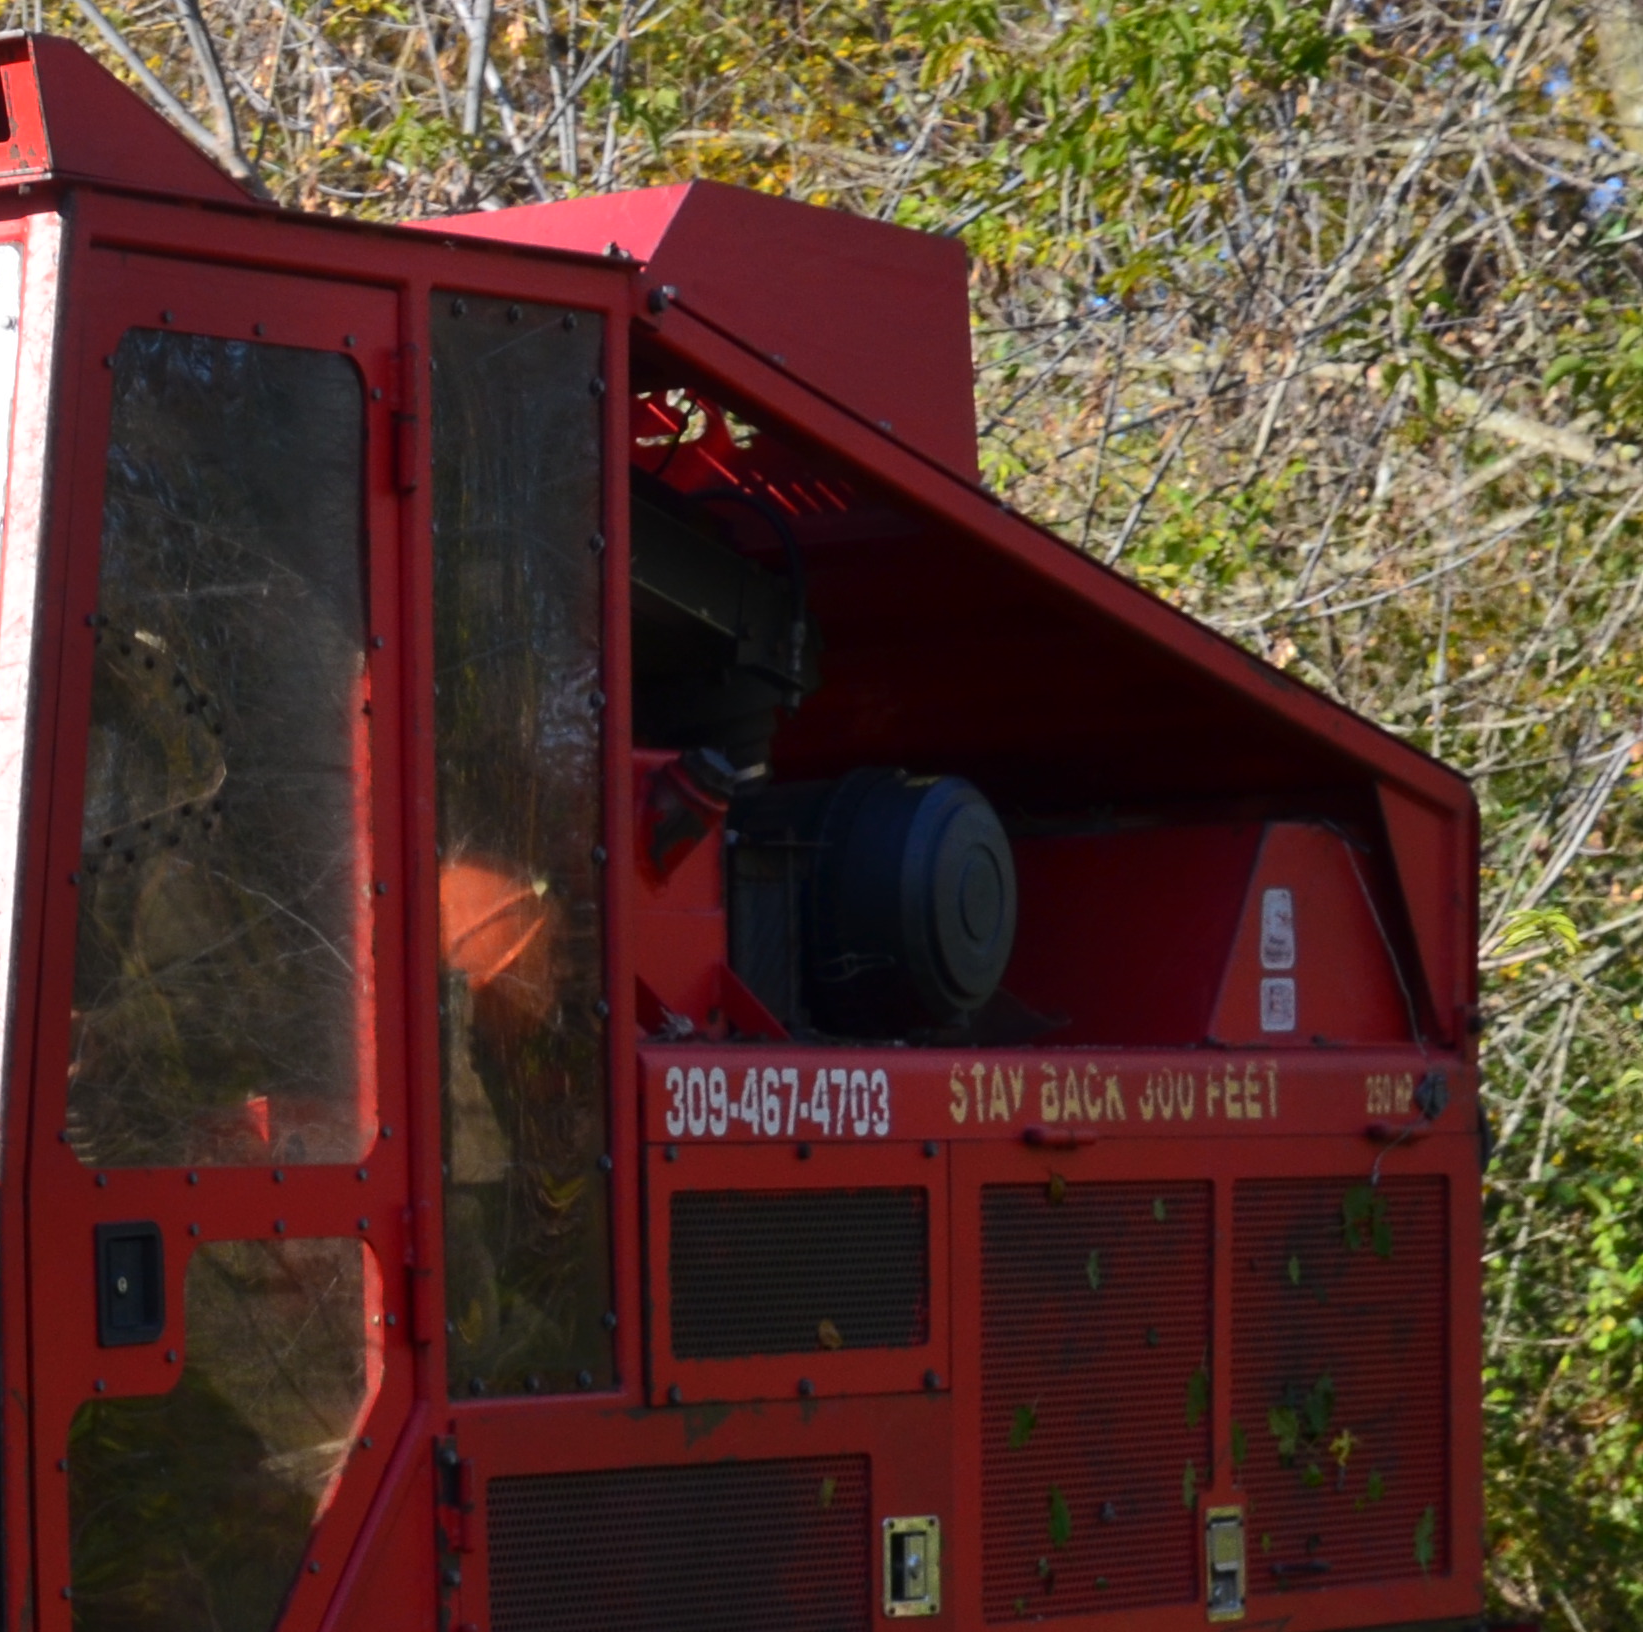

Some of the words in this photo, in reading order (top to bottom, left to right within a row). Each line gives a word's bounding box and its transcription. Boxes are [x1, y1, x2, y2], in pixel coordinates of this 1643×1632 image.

[665, 1065, 890, 1138] 309-467-4703
[948, 1060, 1025, 1125] STAY
[1040, 1060, 1127, 1123] BACK
[1138, 1064, 1196, 1122] 300
[1206, 1059, 1279, 1121] FEET
